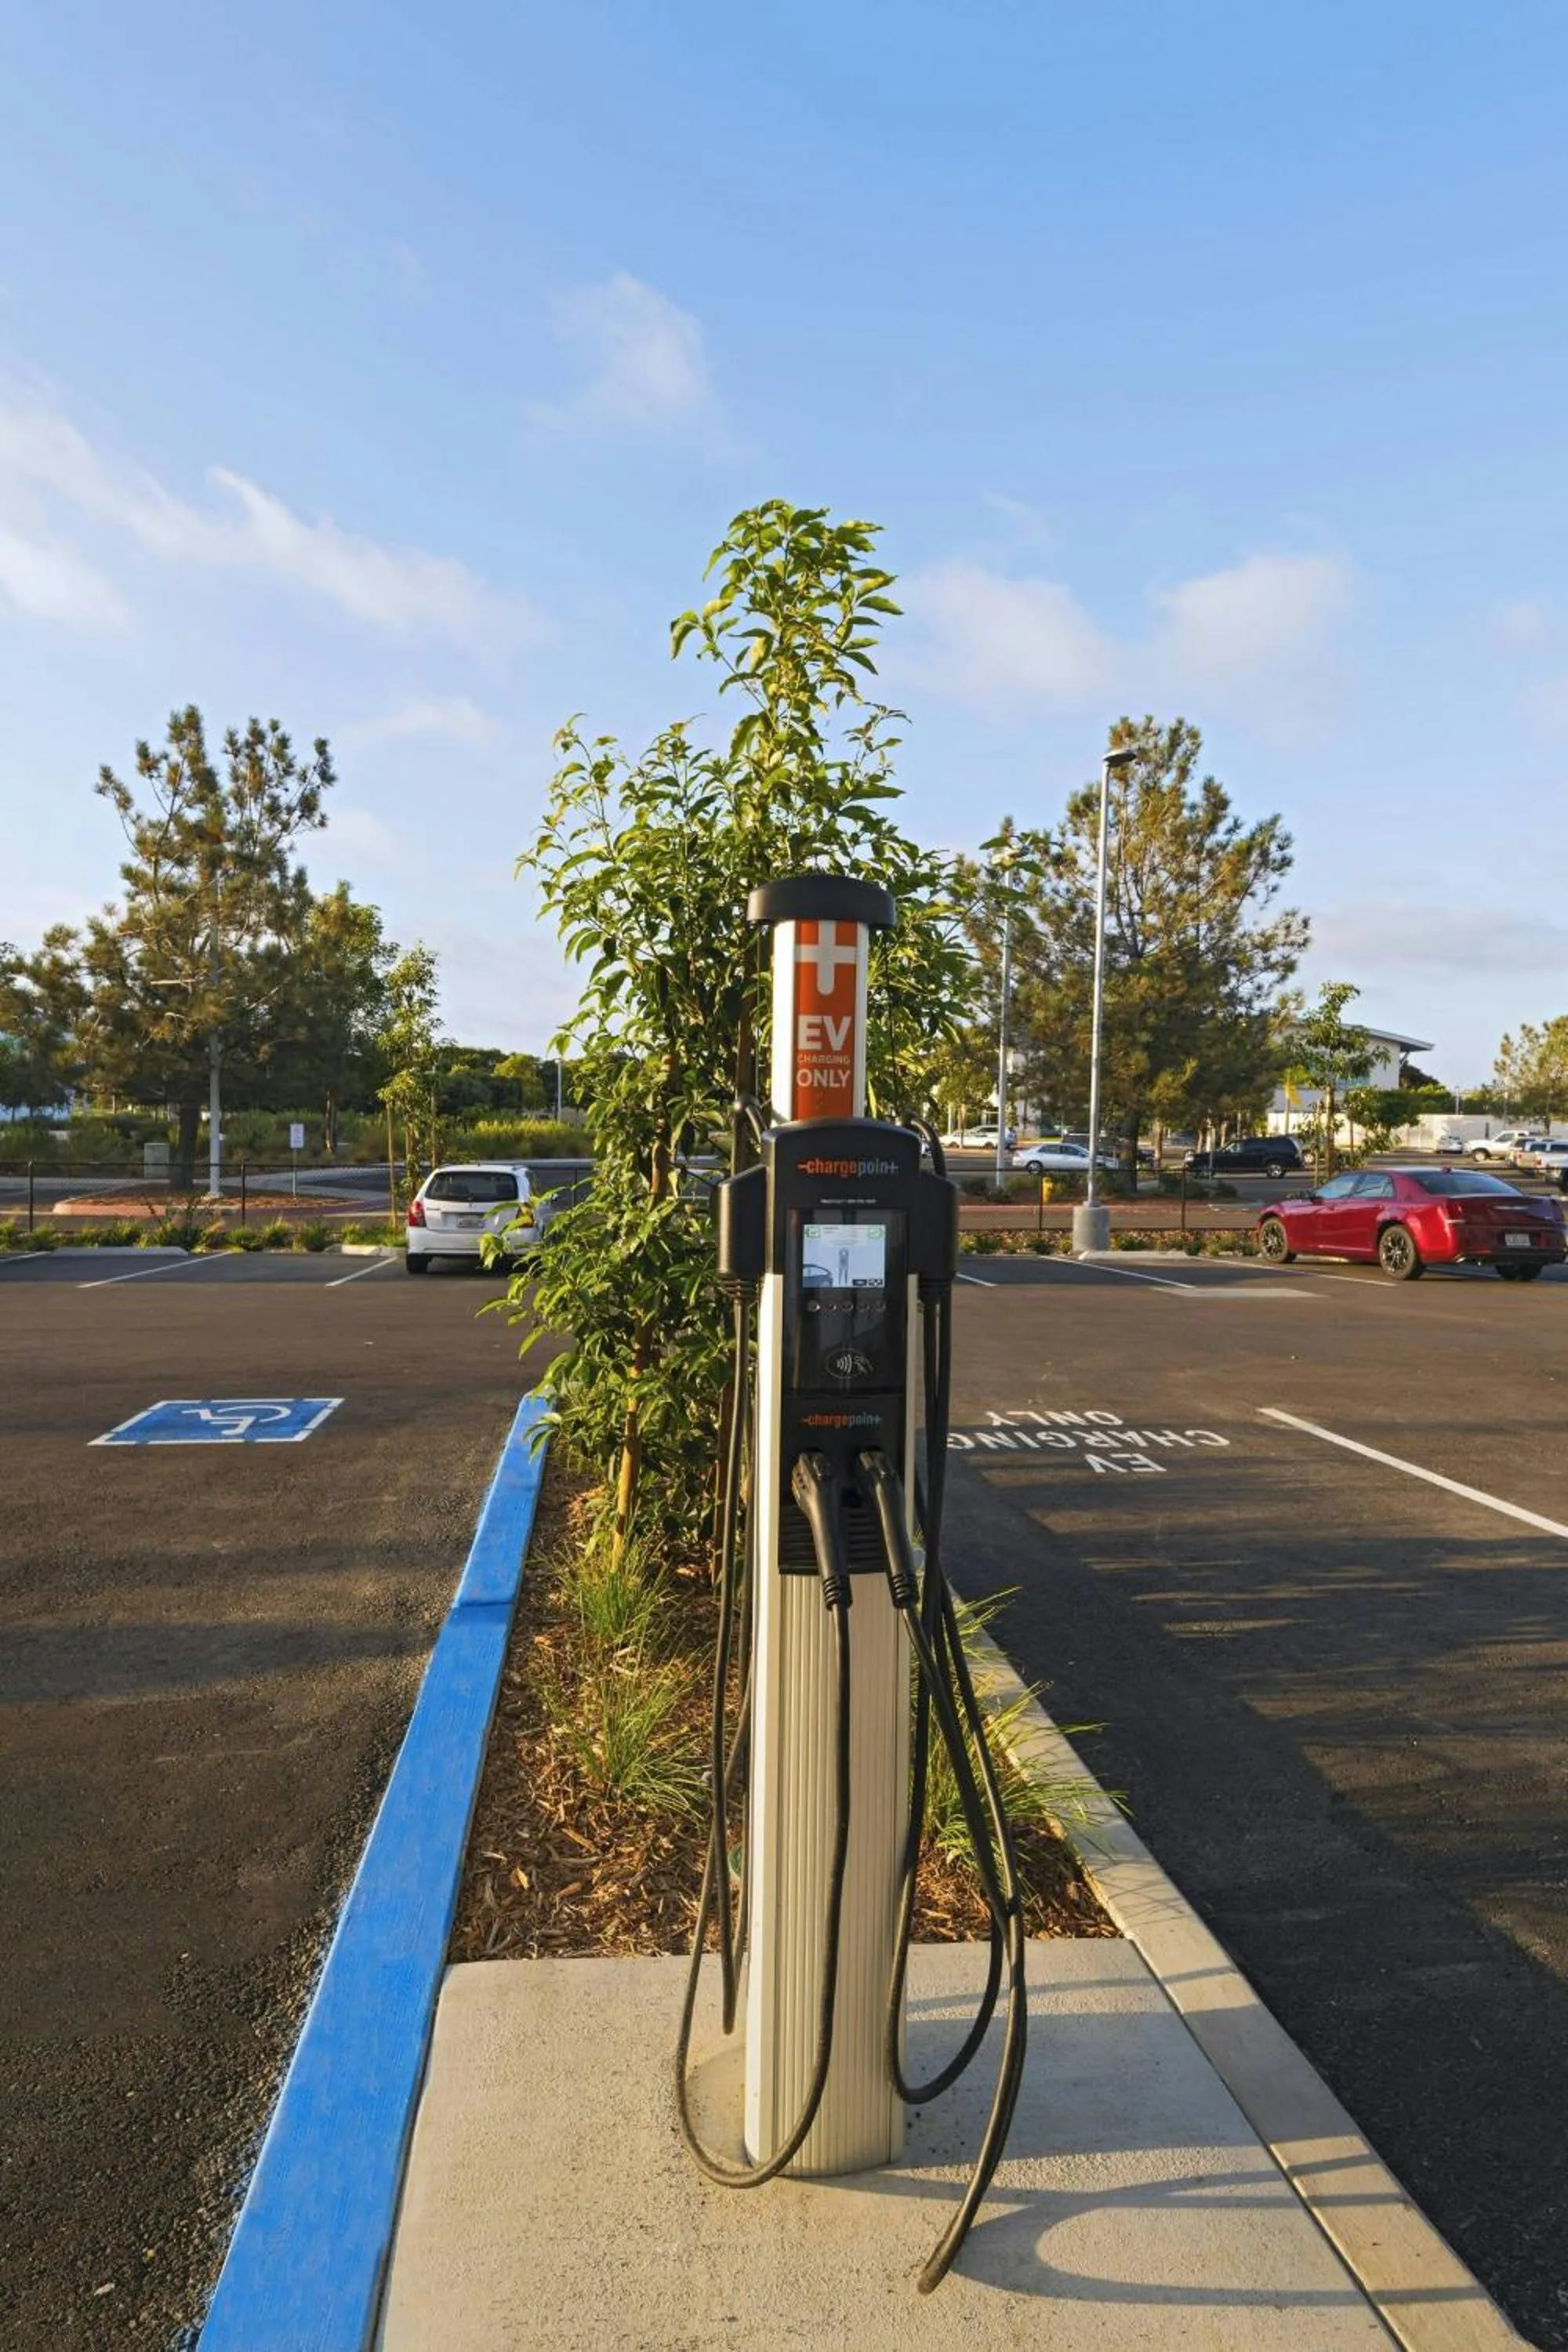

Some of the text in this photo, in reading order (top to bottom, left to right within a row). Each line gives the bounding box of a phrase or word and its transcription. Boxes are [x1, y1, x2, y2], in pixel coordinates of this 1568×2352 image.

[798, 1014, 852, 1051] EV
[797, 1054, 851, 1065] CHARGING
[797, 1069, 851, 1088] ONLY
[985, 1410, 1123, 1426] ONLY
[947, 1429, 1231, 1450] CHARGING
[1084, 1453, 1168, 1473] EV
